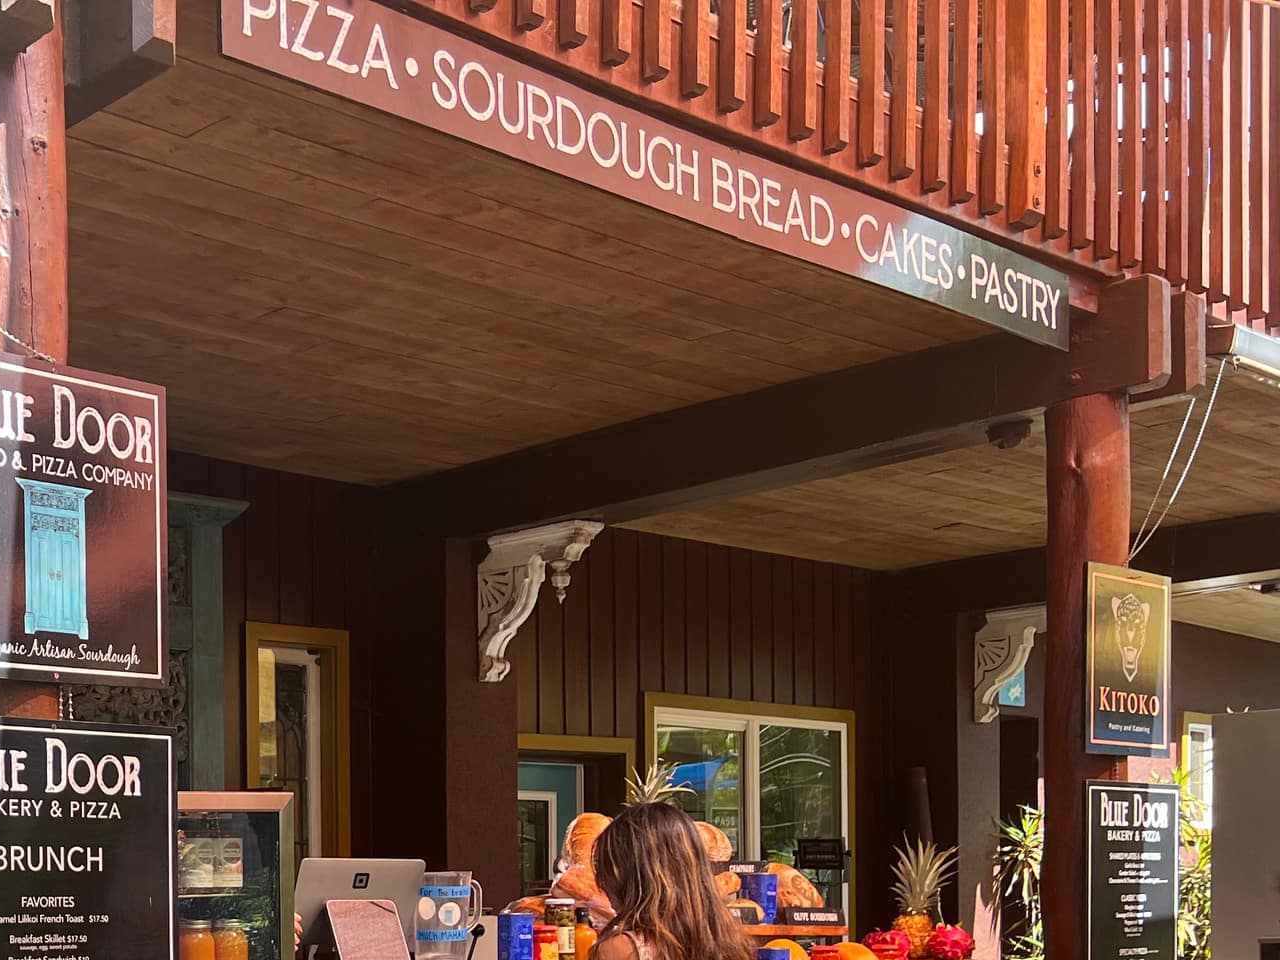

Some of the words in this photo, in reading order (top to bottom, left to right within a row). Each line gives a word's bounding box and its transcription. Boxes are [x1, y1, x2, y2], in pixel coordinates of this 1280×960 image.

[242, 0, 399, 89] PIZZA
[431, 49, 700, 202] SOURDOUGH
[712, 157, 835, 247] BREAD
[855, 213, 954, 290] CAKES
[971, 254, 1061, 330] PASTRY
[52, 384, 153, 464] DOOR
[12, 451, 28, 471] &
[32, 455, 78, 479] PIZZA
[82, 463, 153, 491] COMPANY
[27, 638, 75, 660] Artisan
[77, 643, 140, 669] Sourdough
[1099, 686, 1160, 716] KITOKO
[45, 737, 142, 796] DOOR
[50, 801, 63, 818] &
[70, 801, 121, 819] PIZZA
[1100, 792, 1129, 827] BLUE
[1107, 830, 1133, 841] BAKERY
[1142, 830, 1161, 842] PIZZA
[21, 896, 75, 907] FAVORITES
[40, 914, 64, 924] French
[65, 914, 84, 923] Toast
[89, 914, 109, 923] $17.50
[9, 935, 43, 944] Breakfast
[44, 934, 66, 944] Skillet
[67, 935, 87, 943] $17.50
